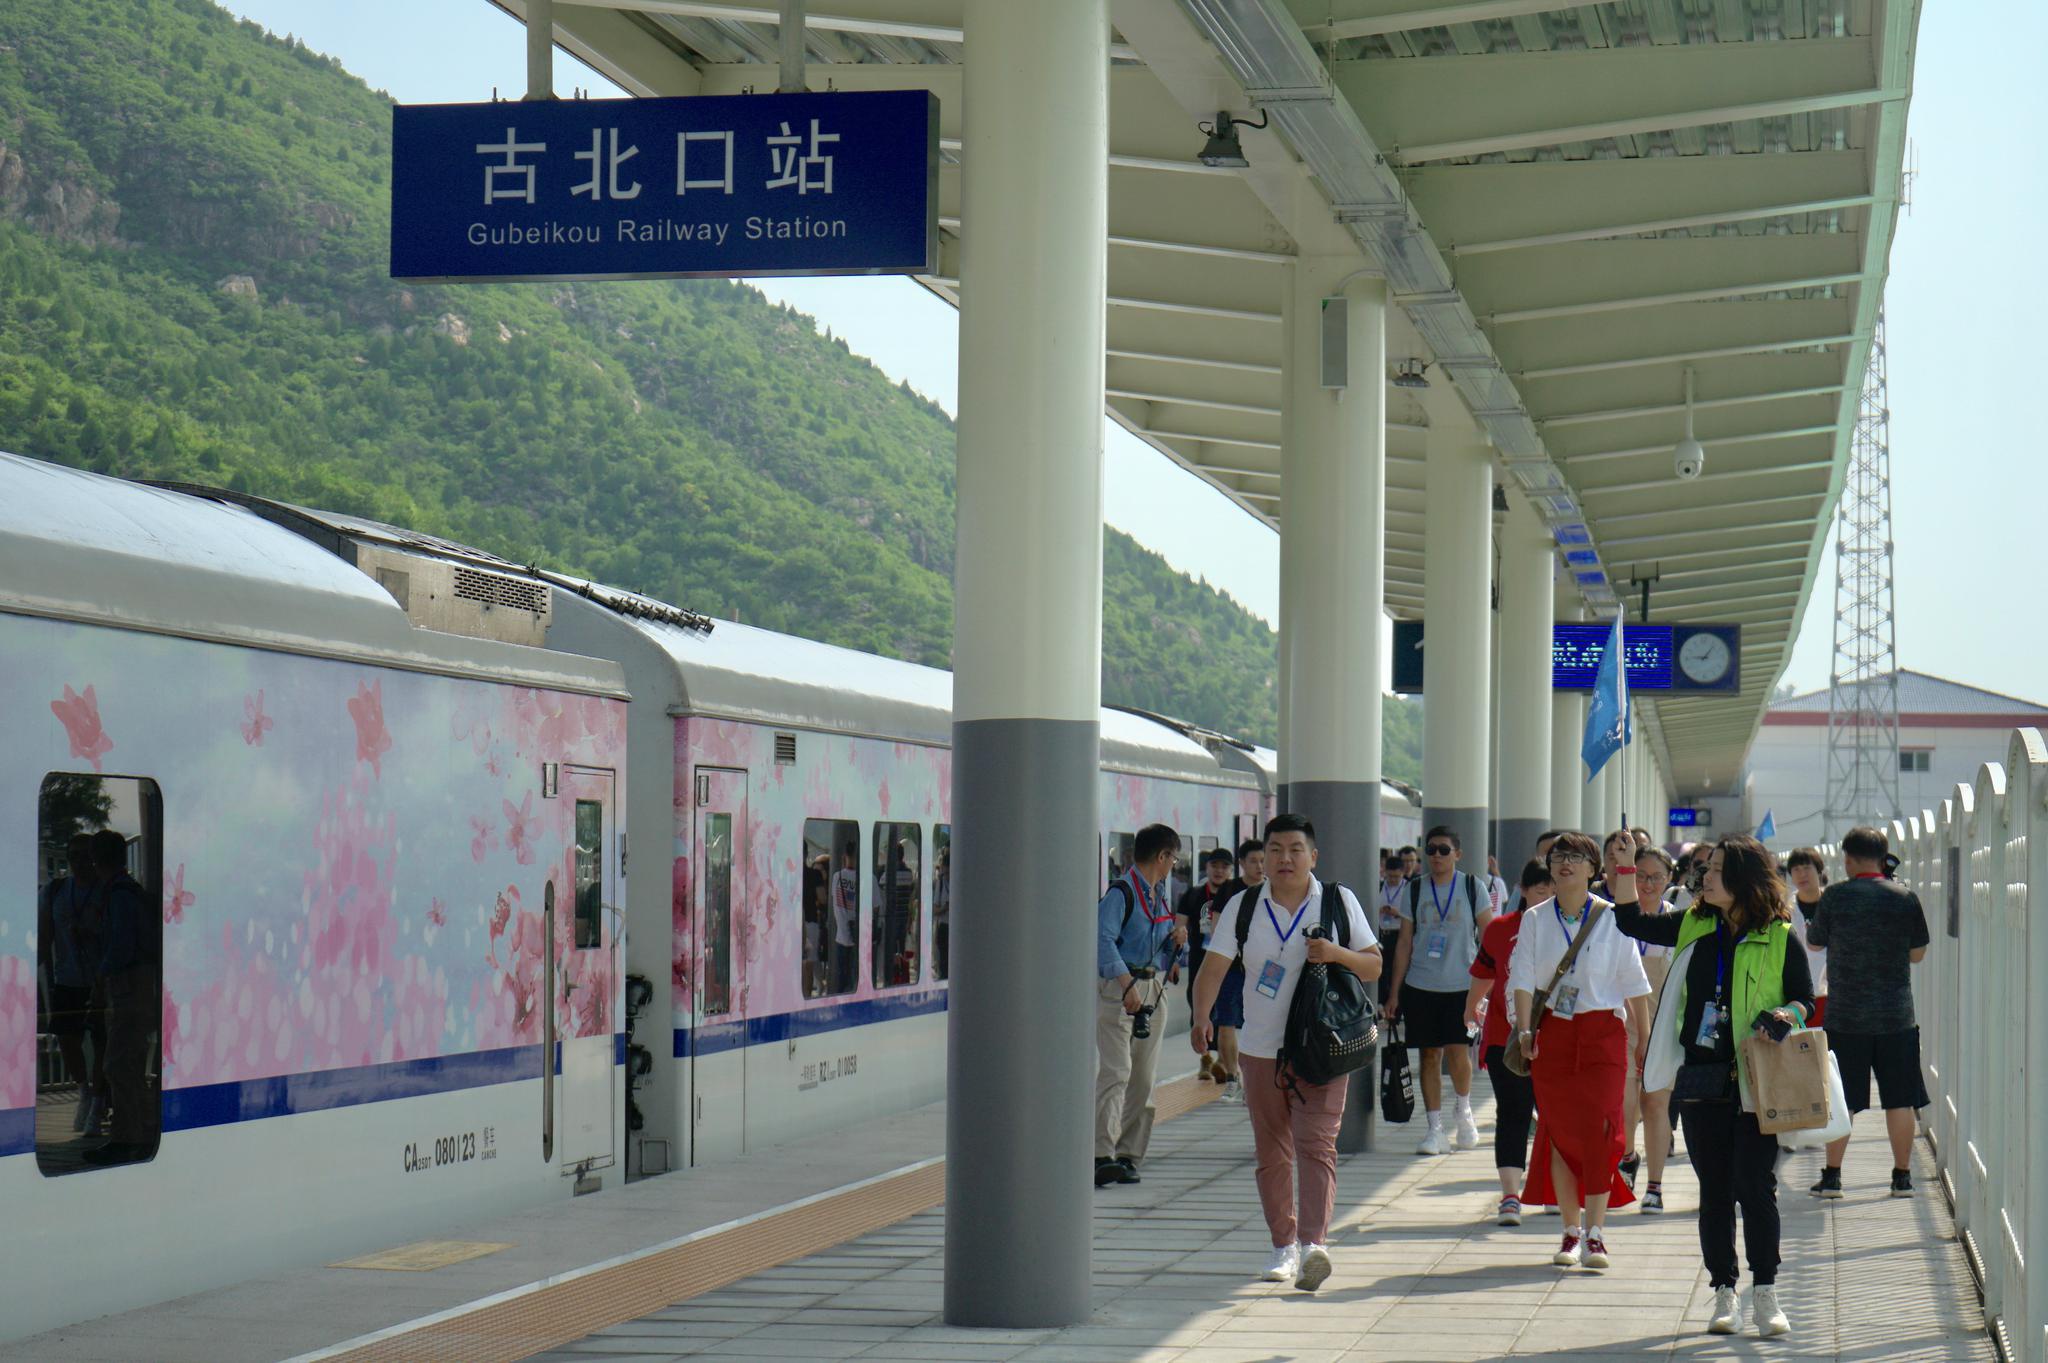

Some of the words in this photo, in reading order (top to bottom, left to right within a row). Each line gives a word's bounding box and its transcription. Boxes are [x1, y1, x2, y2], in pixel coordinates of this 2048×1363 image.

[476, 118, 841, 205] 古北口站
[468, 221, 600, 245] Gubeikou
[618, 218, 729, 246] Railway
[745, 216, 847, 239] Station
[435, 1131, 476, 1167] 080123
